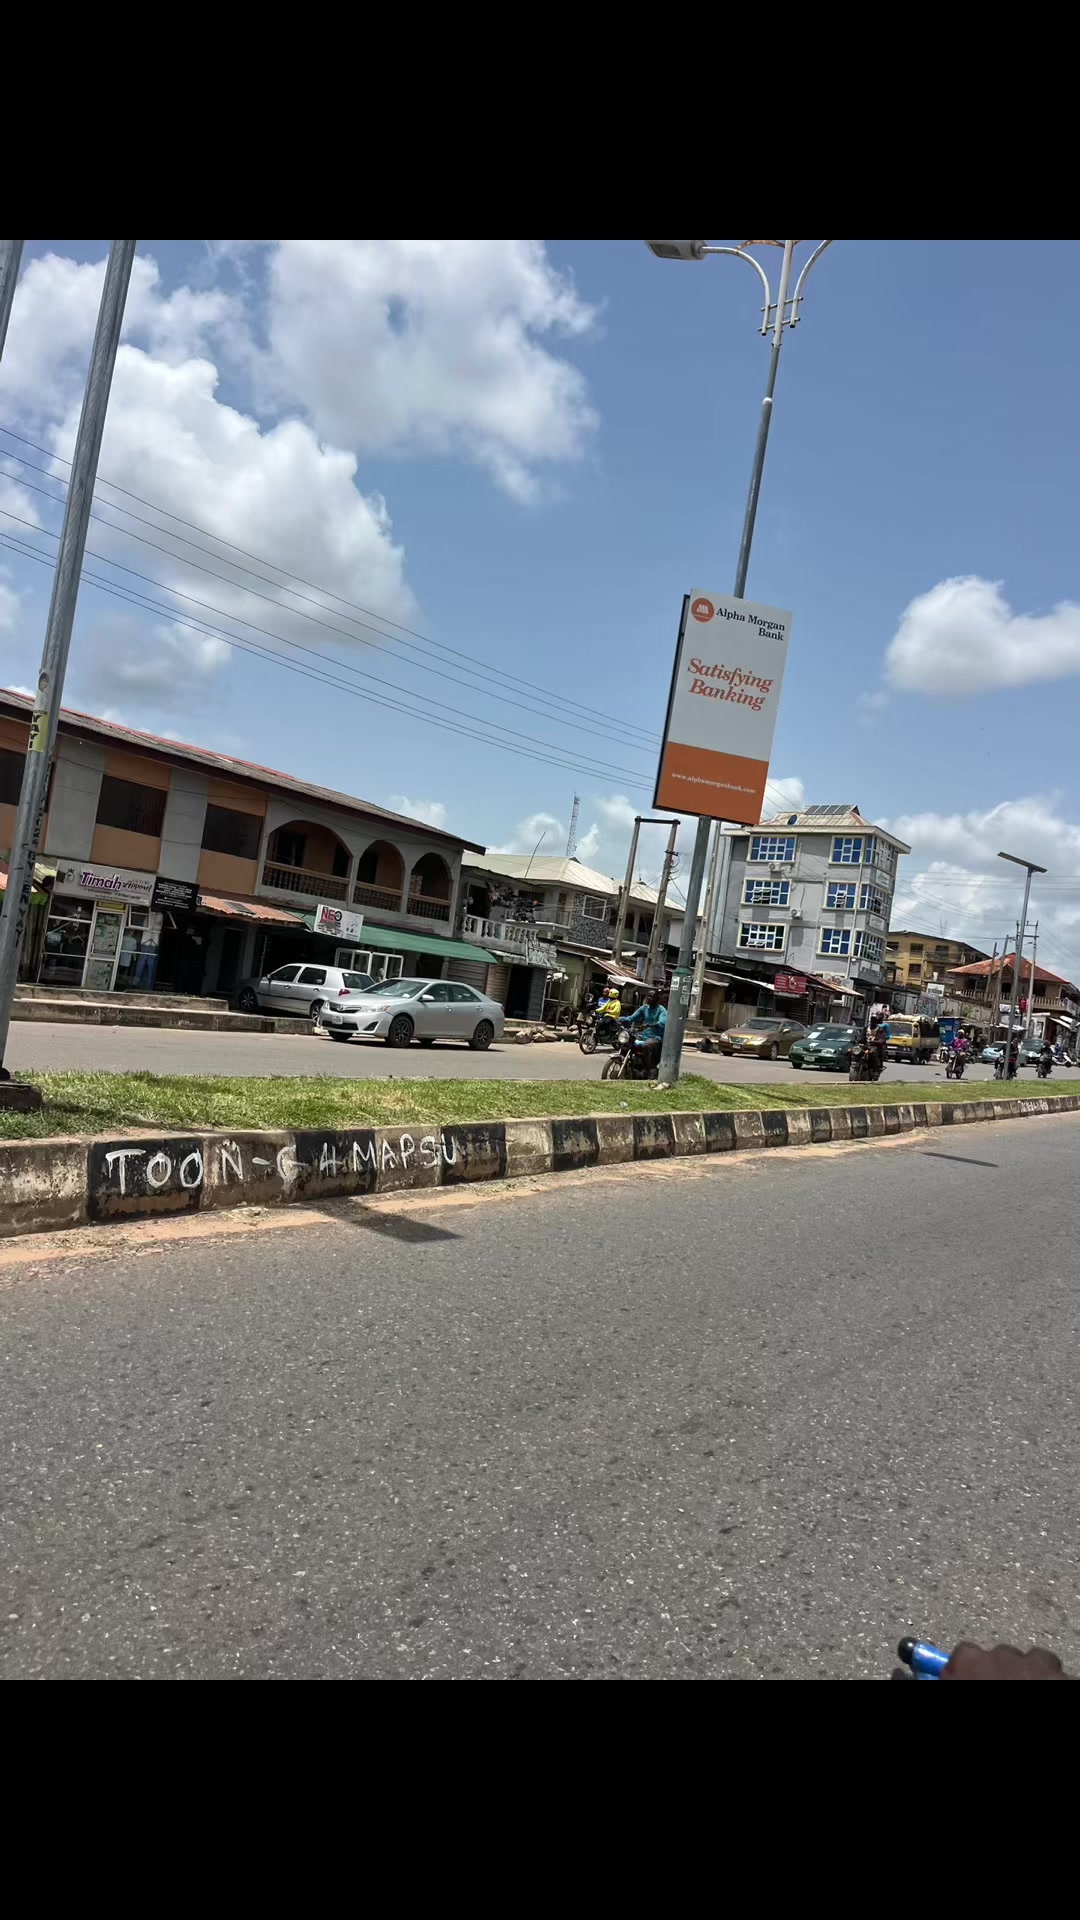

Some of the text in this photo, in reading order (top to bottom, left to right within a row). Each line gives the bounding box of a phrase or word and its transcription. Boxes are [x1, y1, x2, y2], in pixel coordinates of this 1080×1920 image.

[716, 608, 785, 631] Alpha Morgan
[758, 627, 784, 640] Bank
[687, 658, 773, 693] Satisfying
[689, 678, 764, 711] Banking
[671, 773, 756, 794] www.alphamorganbank.com
[81, 870, 122, 890] Timah
